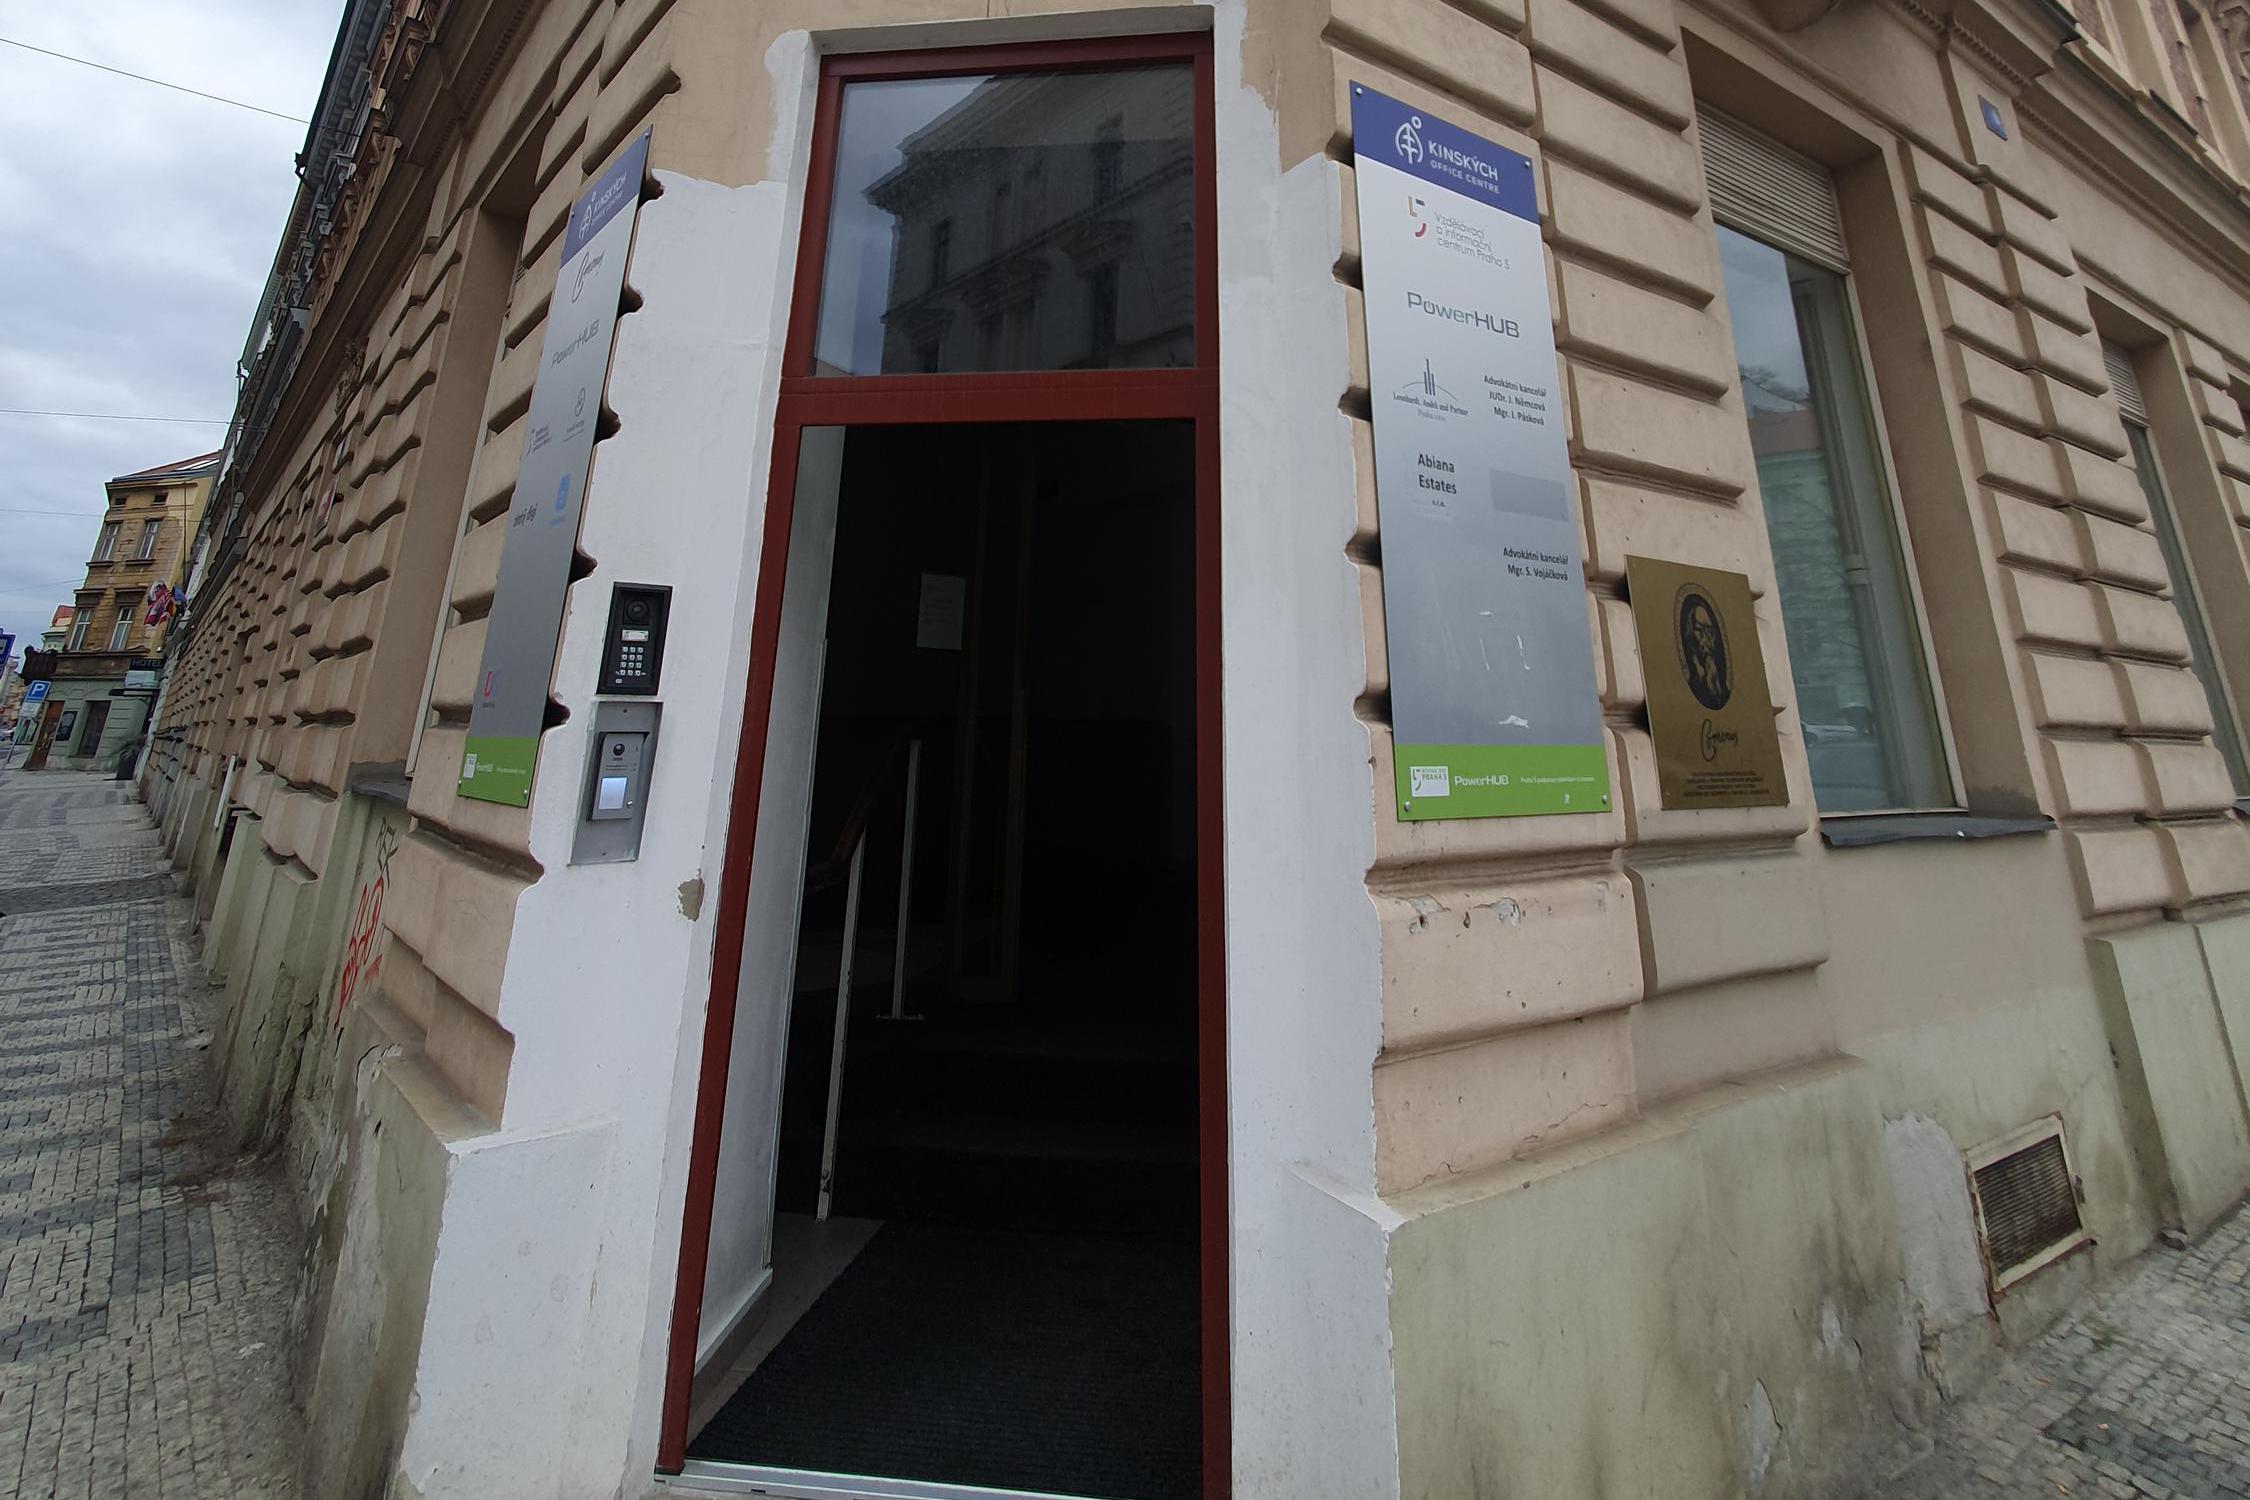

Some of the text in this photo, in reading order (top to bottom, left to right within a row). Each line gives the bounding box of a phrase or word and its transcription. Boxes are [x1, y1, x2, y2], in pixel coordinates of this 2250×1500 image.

[1428, 139, 1499, 181] KINSKÝCH
[1430, 159, 1500, 194] OFFICE CENTRE
[1407, 291, 1520, 338] PowerHUB
[1418, 453, 1455, 474] Abiana
[1419, 474, 1457, 495] Estates
[32, 683, 45, 696] P
[1454, 775, 1510, 786] PowerHUB
